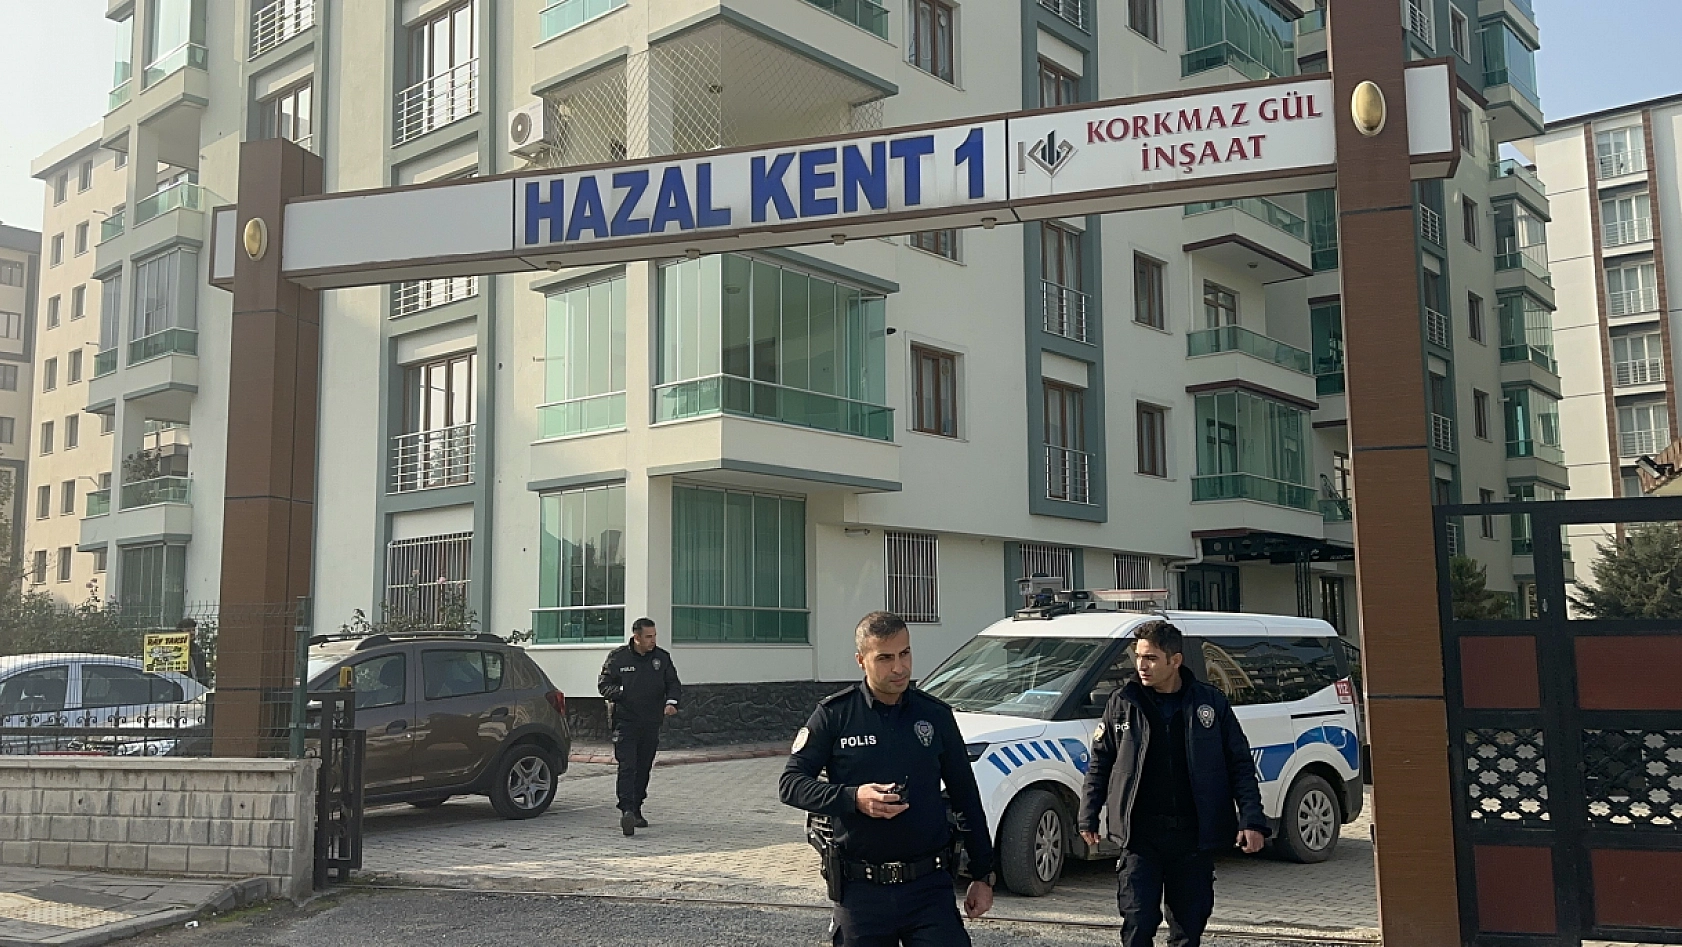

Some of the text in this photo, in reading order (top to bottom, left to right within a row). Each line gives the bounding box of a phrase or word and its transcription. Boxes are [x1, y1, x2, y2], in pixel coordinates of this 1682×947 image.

[1086, 91, 1323, 145] KORKMAZ GÜL
[1141, 134, 1266, 174] İNŞAAT
[524, 127, 985, 245] HAZAL KENT 1
